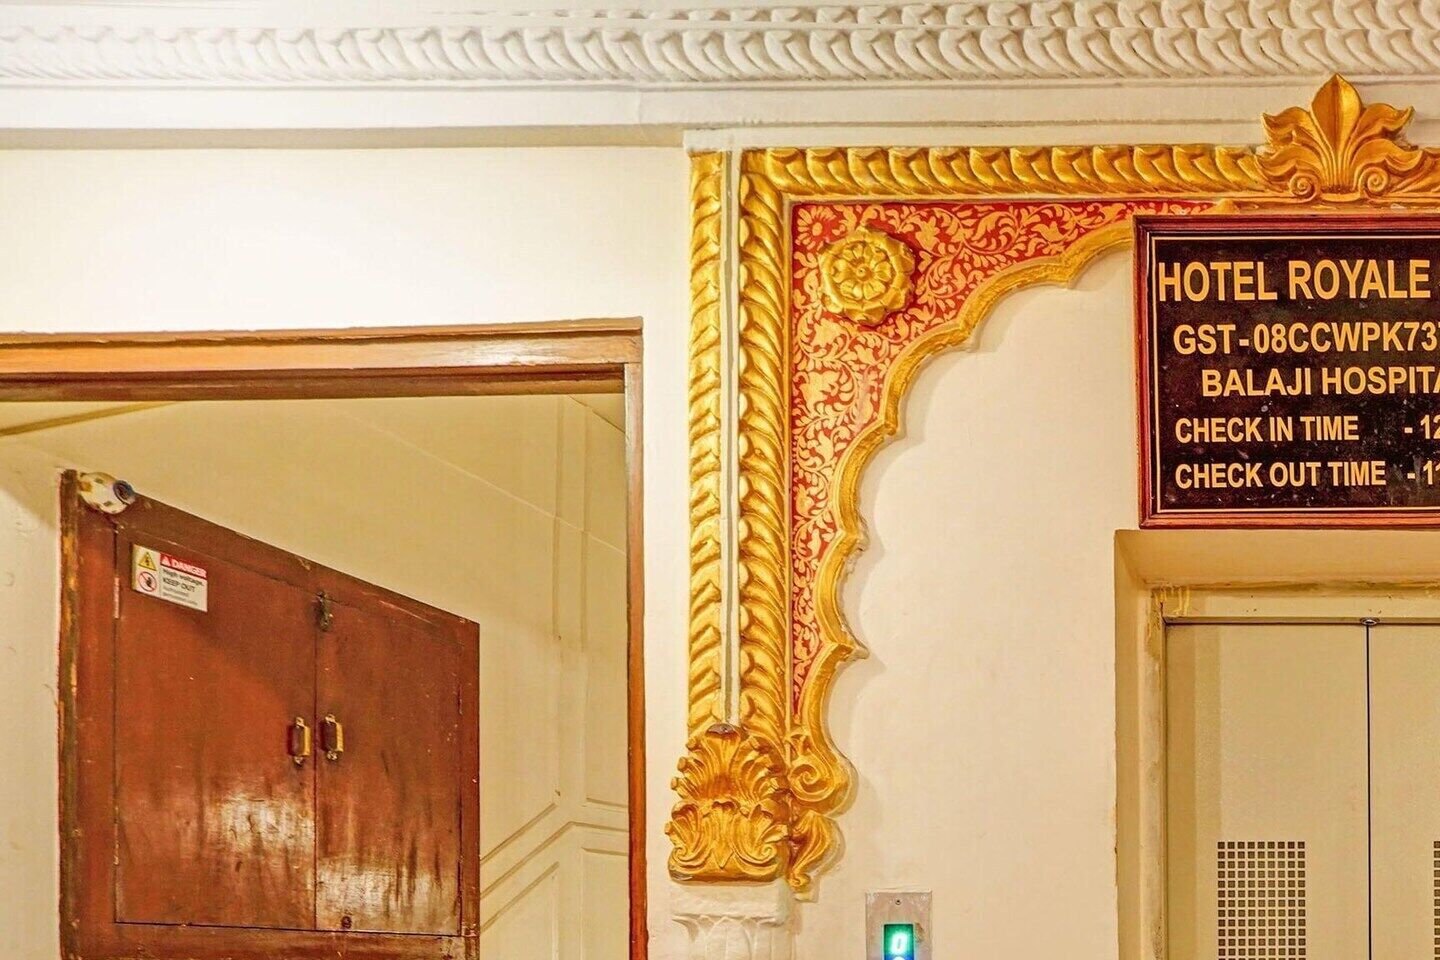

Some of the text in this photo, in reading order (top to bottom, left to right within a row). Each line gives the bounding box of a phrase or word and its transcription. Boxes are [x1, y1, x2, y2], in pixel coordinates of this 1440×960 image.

[1158, 261, 1278, 302] HOTEL
[1288, 259, 1431, 300] ROYALE
[1201, 367, 1312, 397] BALAJI
[1175, 416, 1262, 444] CHECK
[1269, 416, 1293, 442] IN
[1299, 415, 1360, 441] TIME
[1175, 462, 1262, 489] CHECK
[1269, 461, 1322, 488] OUT
[1327, 460, 1387, 487] TIME
[170, 557, 207, 578] DANGER
[162, 577, 180, 587] KEEP
[180, 582, 196, 593] OUT
